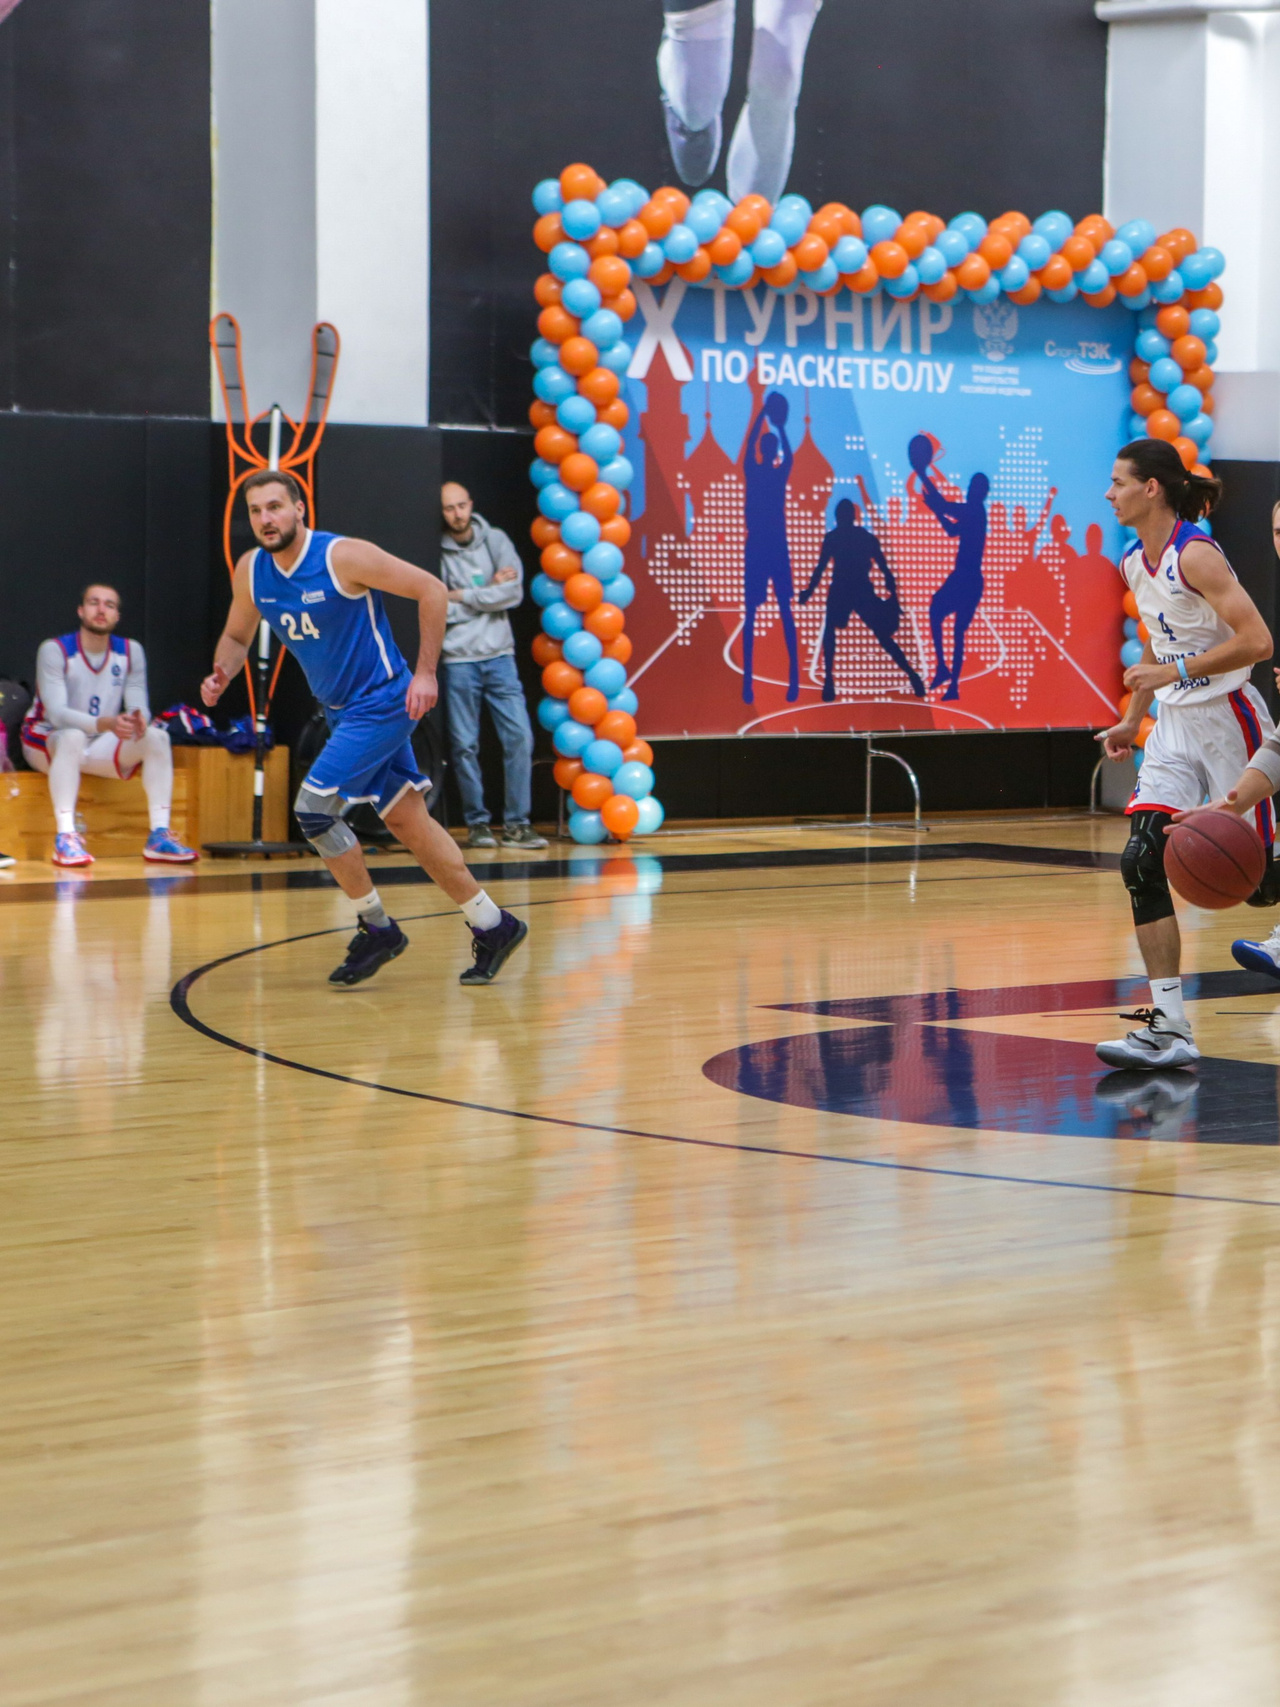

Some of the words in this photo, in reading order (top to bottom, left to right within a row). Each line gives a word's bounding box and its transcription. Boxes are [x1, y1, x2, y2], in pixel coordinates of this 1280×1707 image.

[704, 283, 953, 355] ТУРНИР
[702, 349, 748, 384] ПО
[757, 352, 955, 393] БАСКЕТБОЛУ
[280, 612, 320, 641] 24
[1158, 612, 1177, 641] 4
[88, 695, 101, 717] 8
